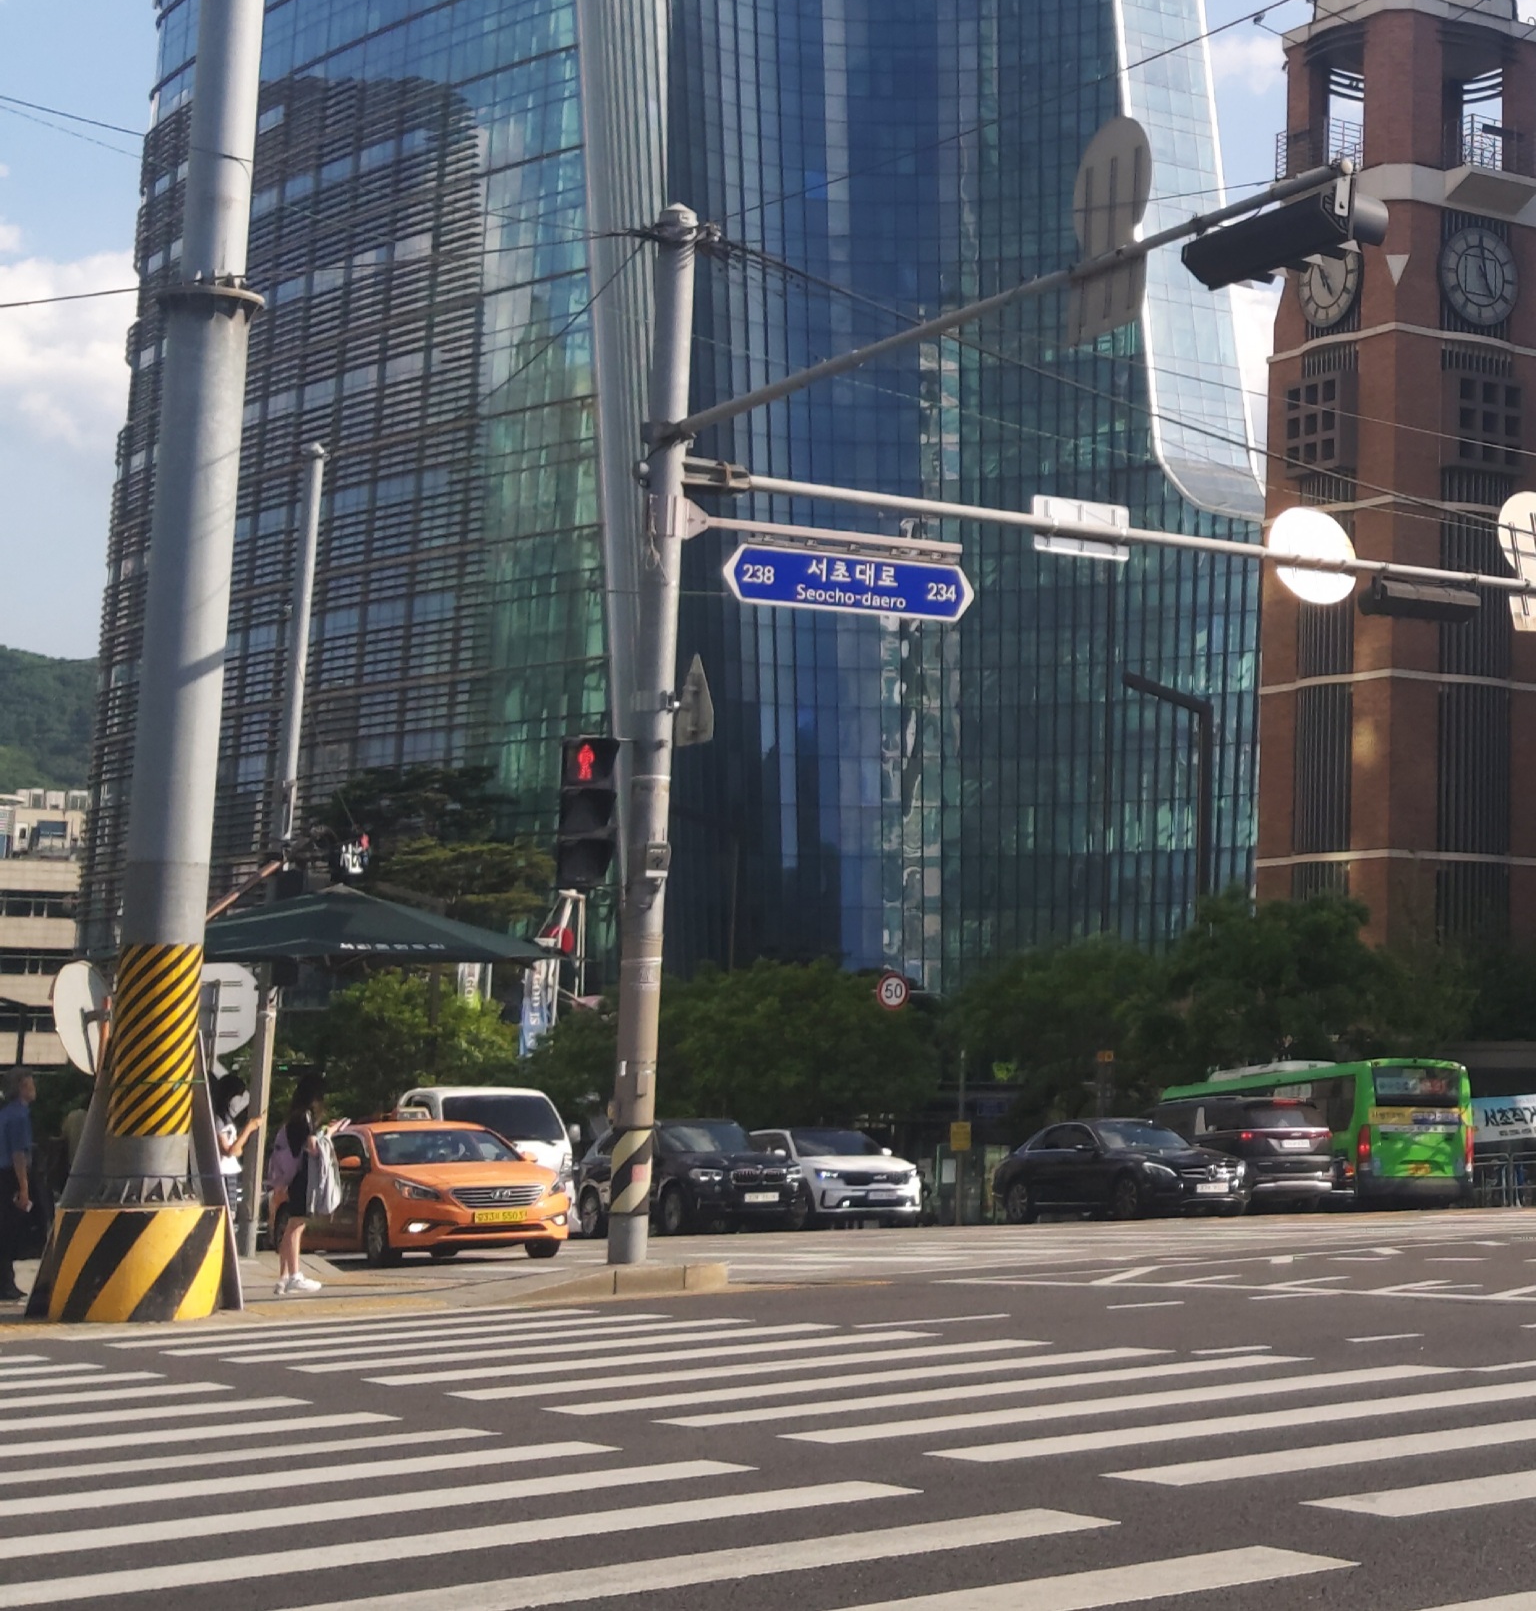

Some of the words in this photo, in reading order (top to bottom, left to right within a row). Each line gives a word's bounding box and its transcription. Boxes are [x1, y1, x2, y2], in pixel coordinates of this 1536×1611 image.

[742, 564, 775, 585] 238
[807, 558, 899, 588] 서초대로
[796, 584, 906, 609] Seocho-daero
[927, 583, 957, 603] 234
[884, 983, 903, 1000] 50
